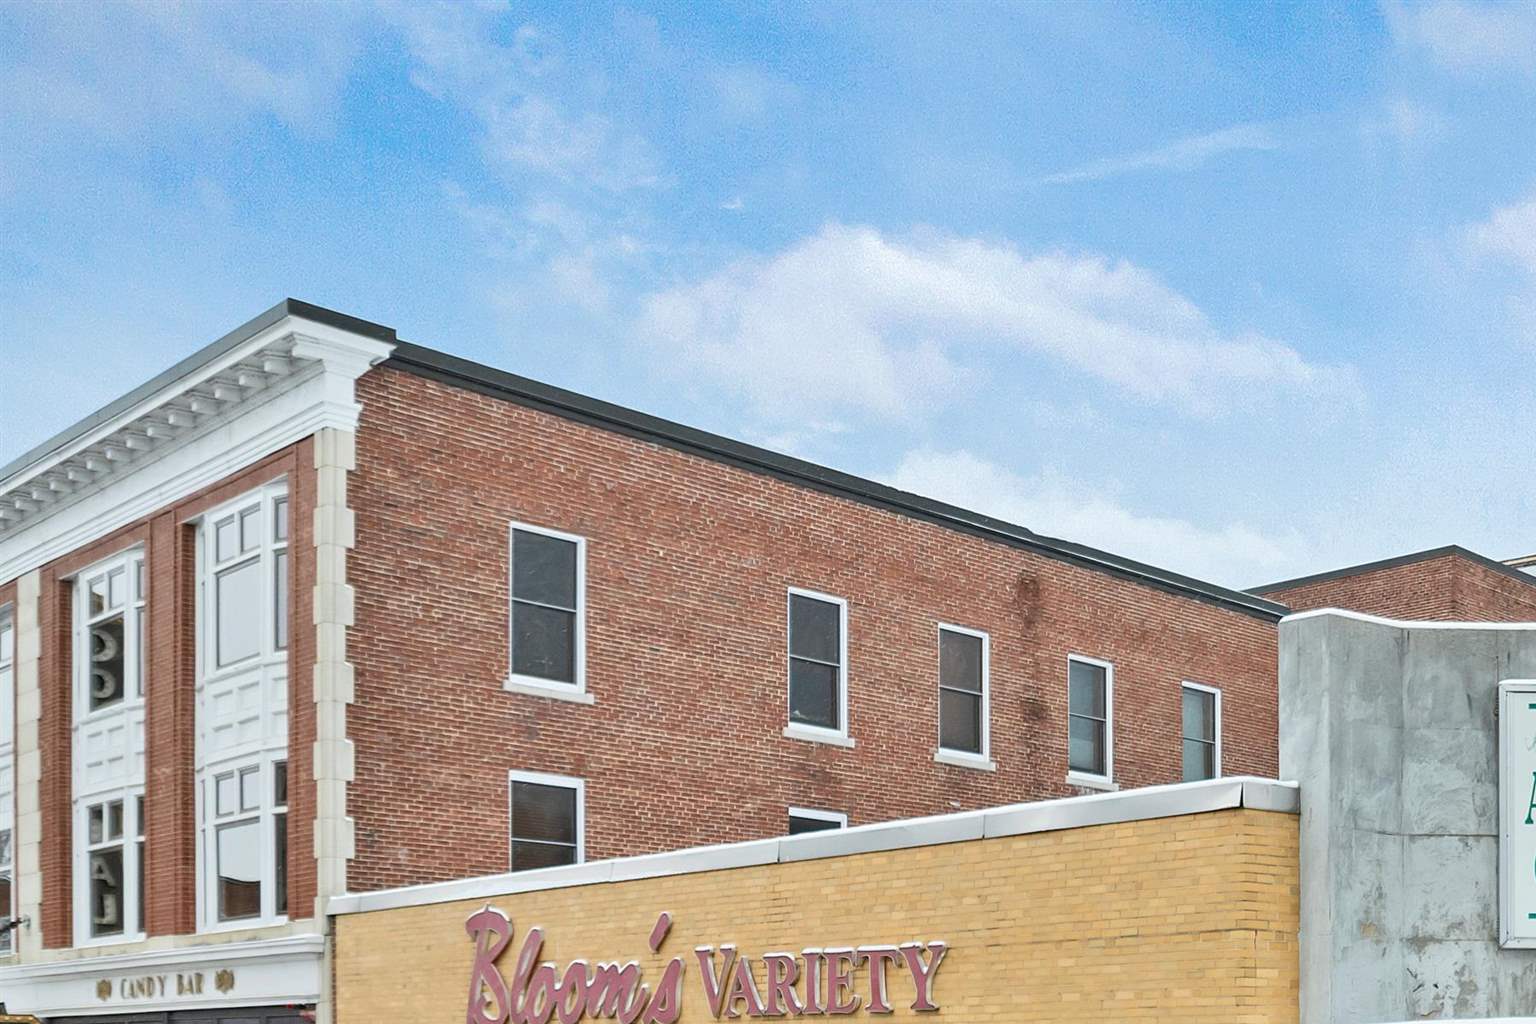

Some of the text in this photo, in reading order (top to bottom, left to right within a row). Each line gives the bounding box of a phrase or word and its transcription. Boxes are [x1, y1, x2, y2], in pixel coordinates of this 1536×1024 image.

[120, 972, 204, 999] CANDY BAR
[695, 940, 948, 1019] VARIETY
